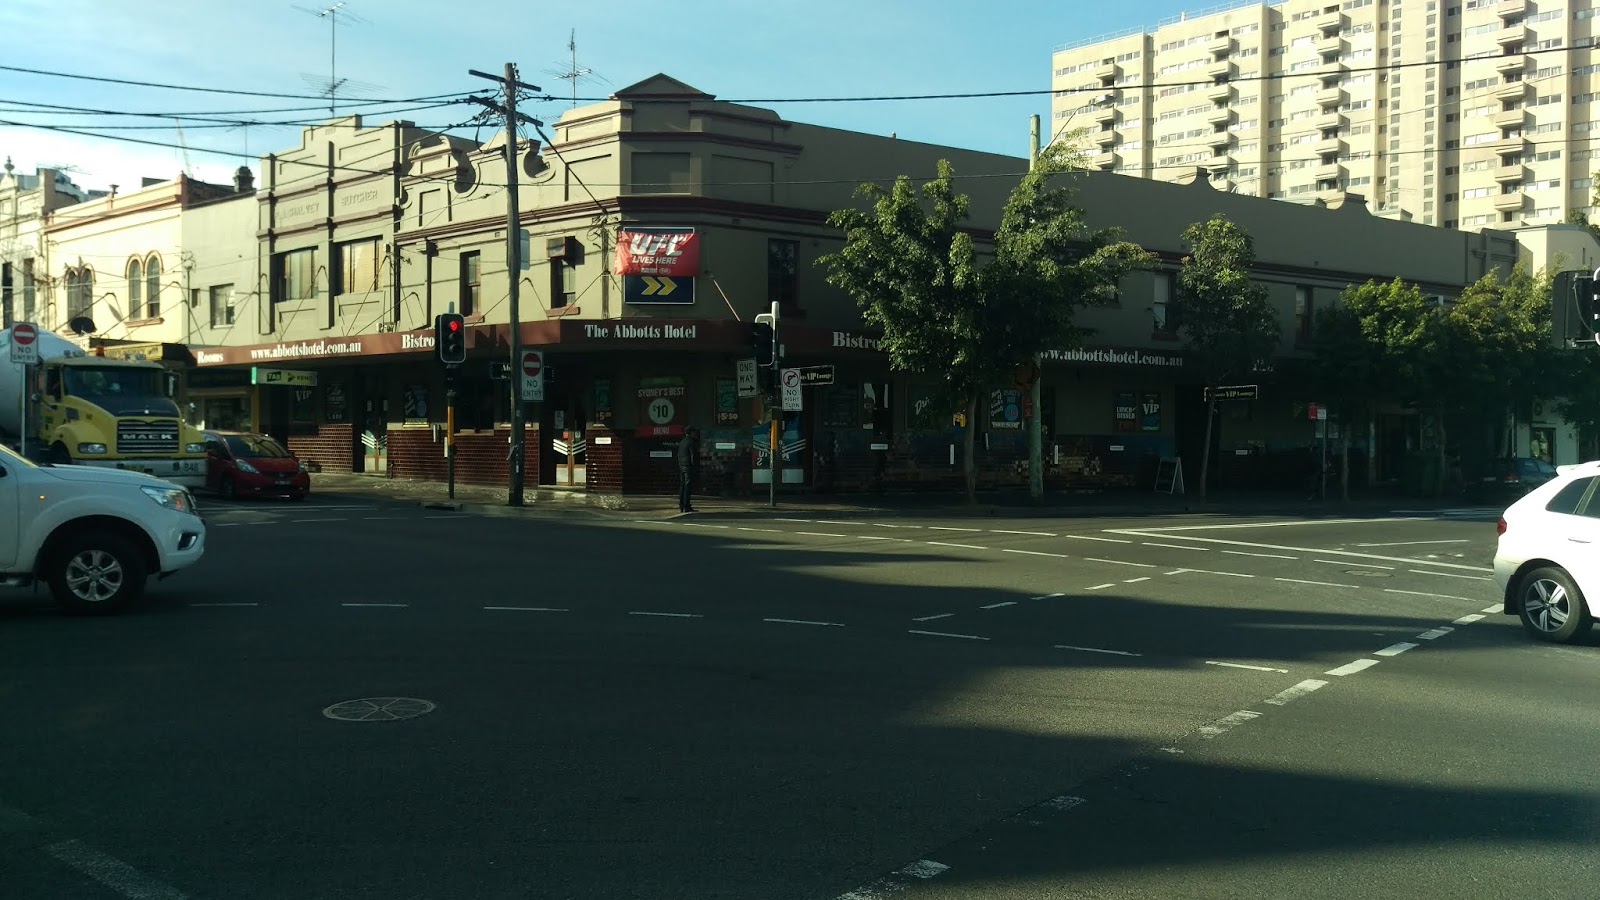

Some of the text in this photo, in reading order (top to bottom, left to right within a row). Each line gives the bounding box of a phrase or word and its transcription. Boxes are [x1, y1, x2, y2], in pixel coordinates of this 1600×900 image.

[630, 233, 686, 256] UFC
[632, 256, 678, 265] LIVES HERE
[584, 324, 696, 338] The Abbotts Hotel
[401, 333, 435, 349] Bistro
[251, 340, 362, 360] www.abbottshotel.com.au
[196, 351, 224, 364] Rooms
[1040, 347, 1183, 367] ww.abbottshotel.com.au
[739, 362, 754, 372] ONE
[268, 373, 281, 381] TAB
[740, 374, 754, 384] WAY
[807, 372, 817, 381] VIP
[295, 390, 312, 402] VIP
[522, 390, 543, 398] ENTRY
[638, 386, 685, 398] SYDNEY'S BEST
[653, 405, 668, 418] $10
[1142, 403, 1159, 415] VIP
[1116, 412, 1136, 420] DINNER
[653, 426, 670, 436] MENU
